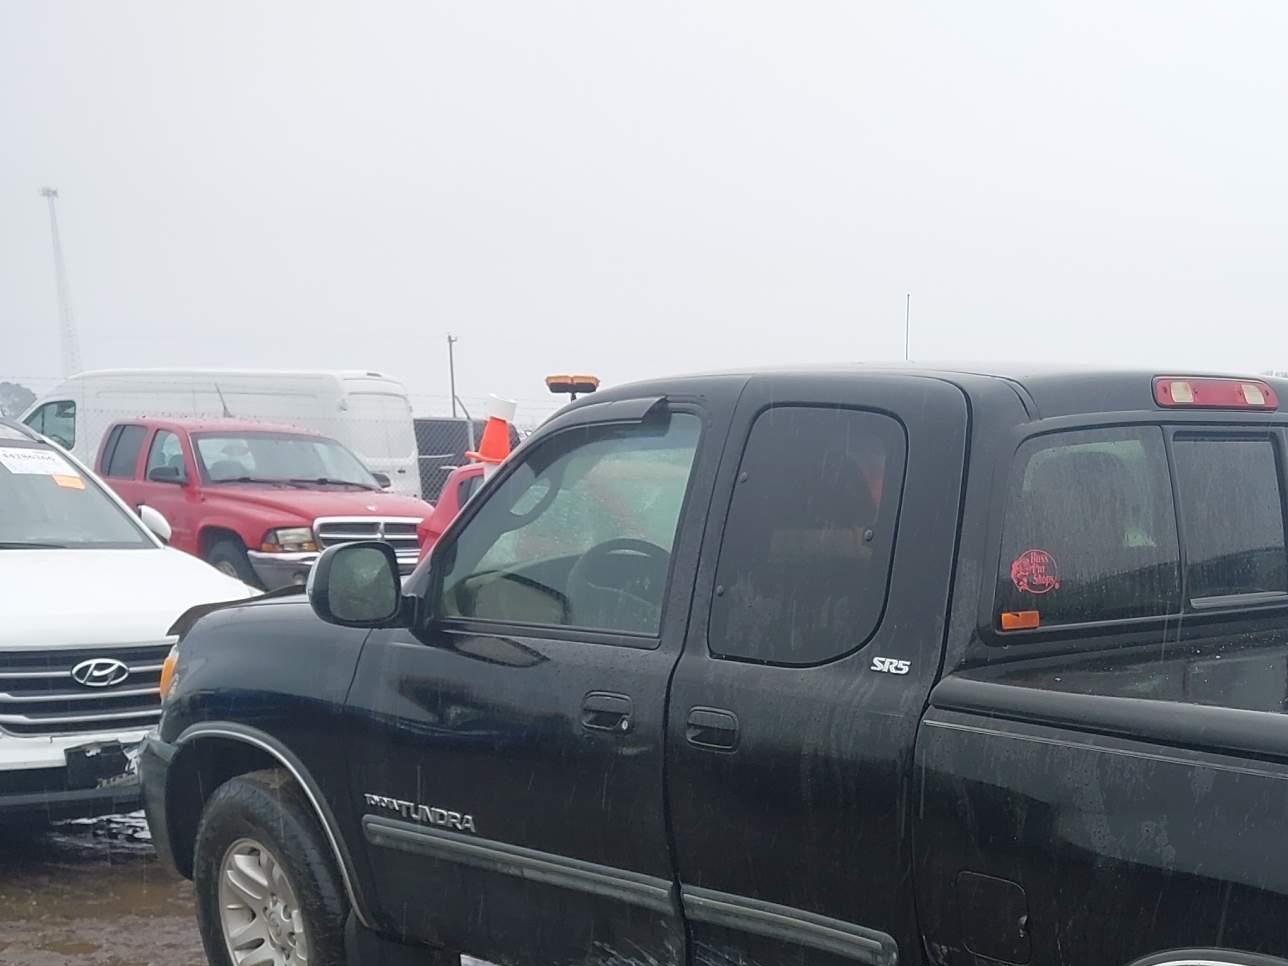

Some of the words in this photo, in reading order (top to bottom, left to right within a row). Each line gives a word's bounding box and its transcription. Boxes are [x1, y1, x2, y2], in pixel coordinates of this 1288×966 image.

[1030, 551, 1049, 564] Bass
[1032, 575, 1057, 587] Shops
[870, 656, 911, 675] SR5
[397, 799, 477, 833] TUNDRA
